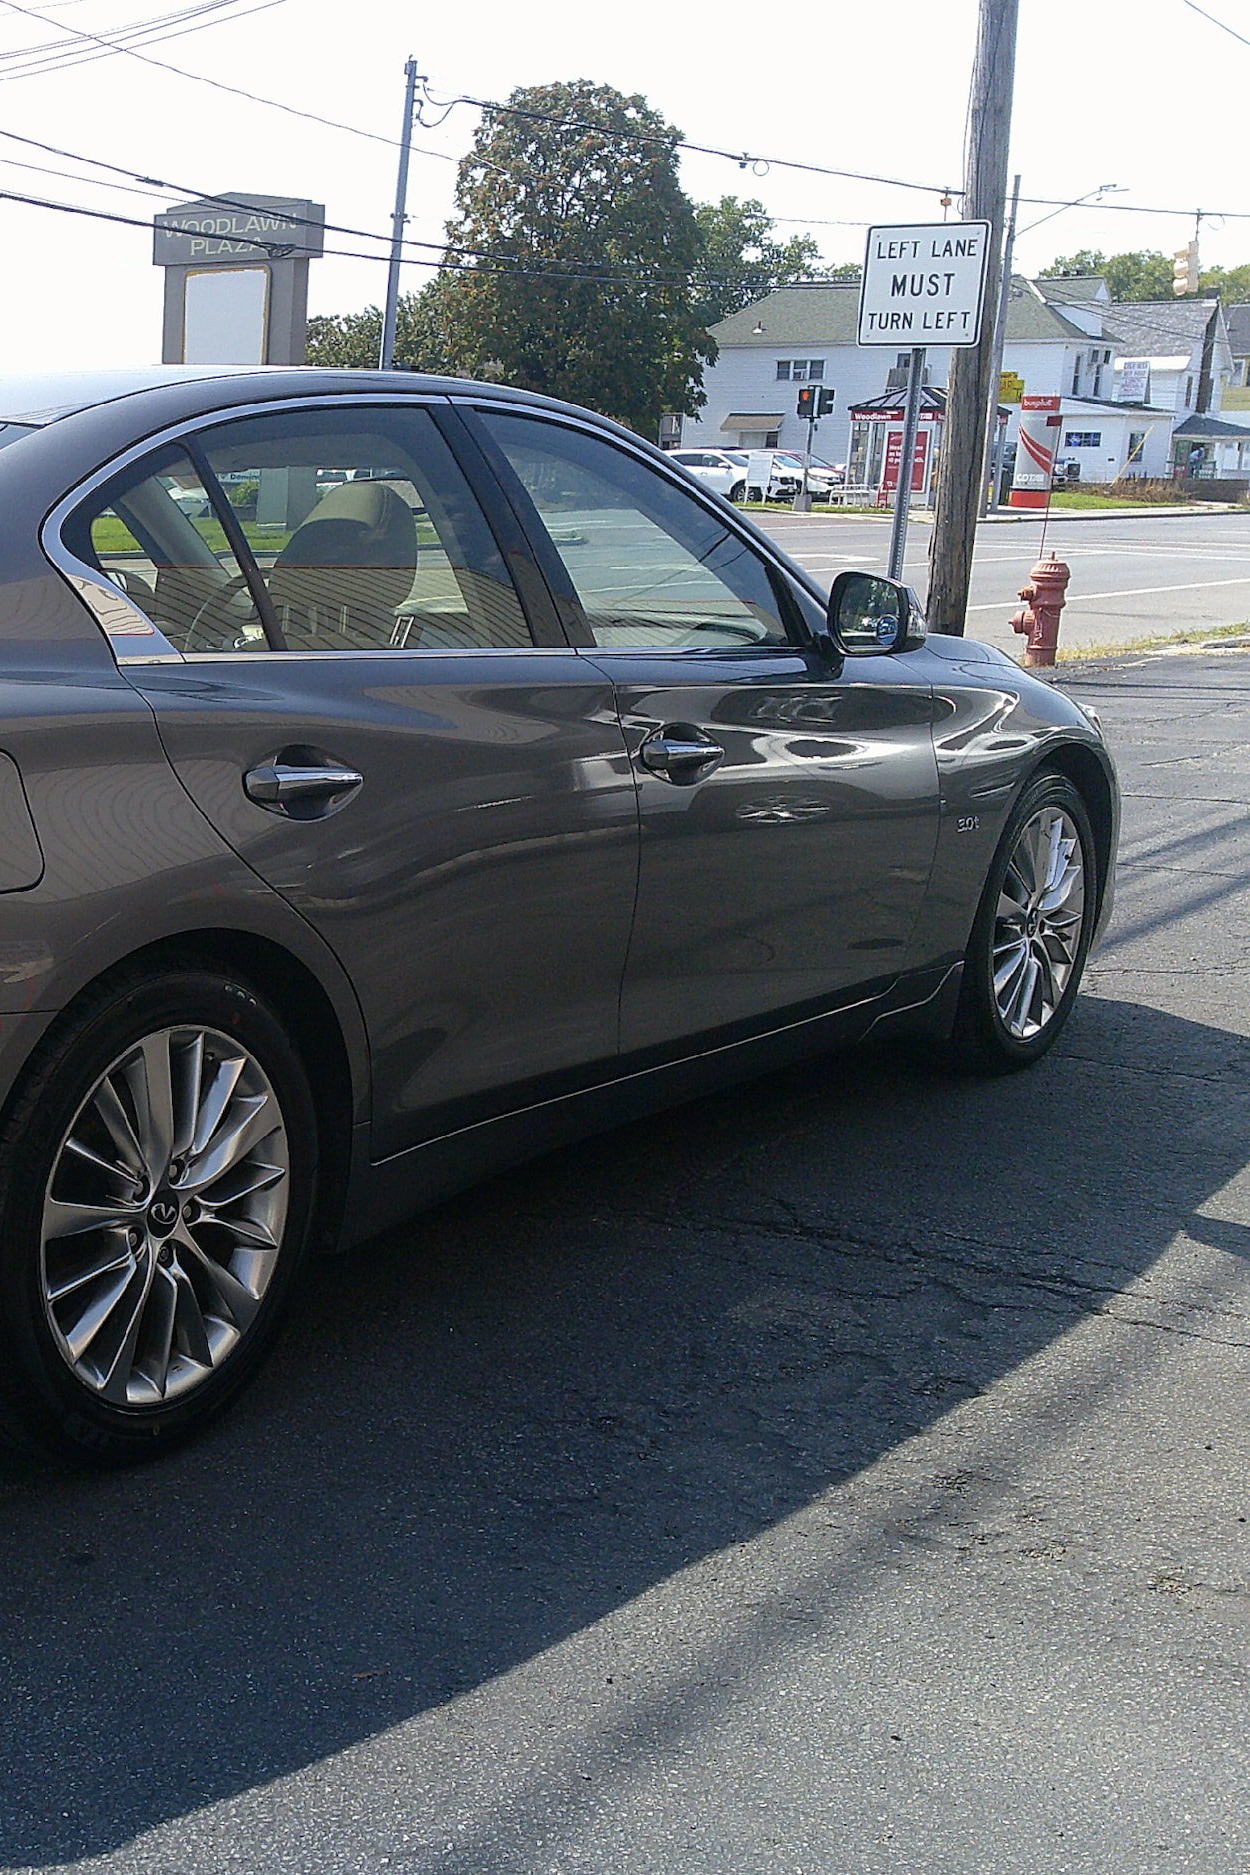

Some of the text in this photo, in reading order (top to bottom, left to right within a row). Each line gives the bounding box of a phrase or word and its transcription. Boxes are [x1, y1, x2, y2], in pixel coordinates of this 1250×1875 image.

[163, 213, 298, 239] WOODLAWN
[190, 237, 267, 256] PLAZA
[877, 239, 978, 259] LEFT LANE
[891, 273, 955, 297] MUST
[868, 312, 970, 330] TURN LEFT
